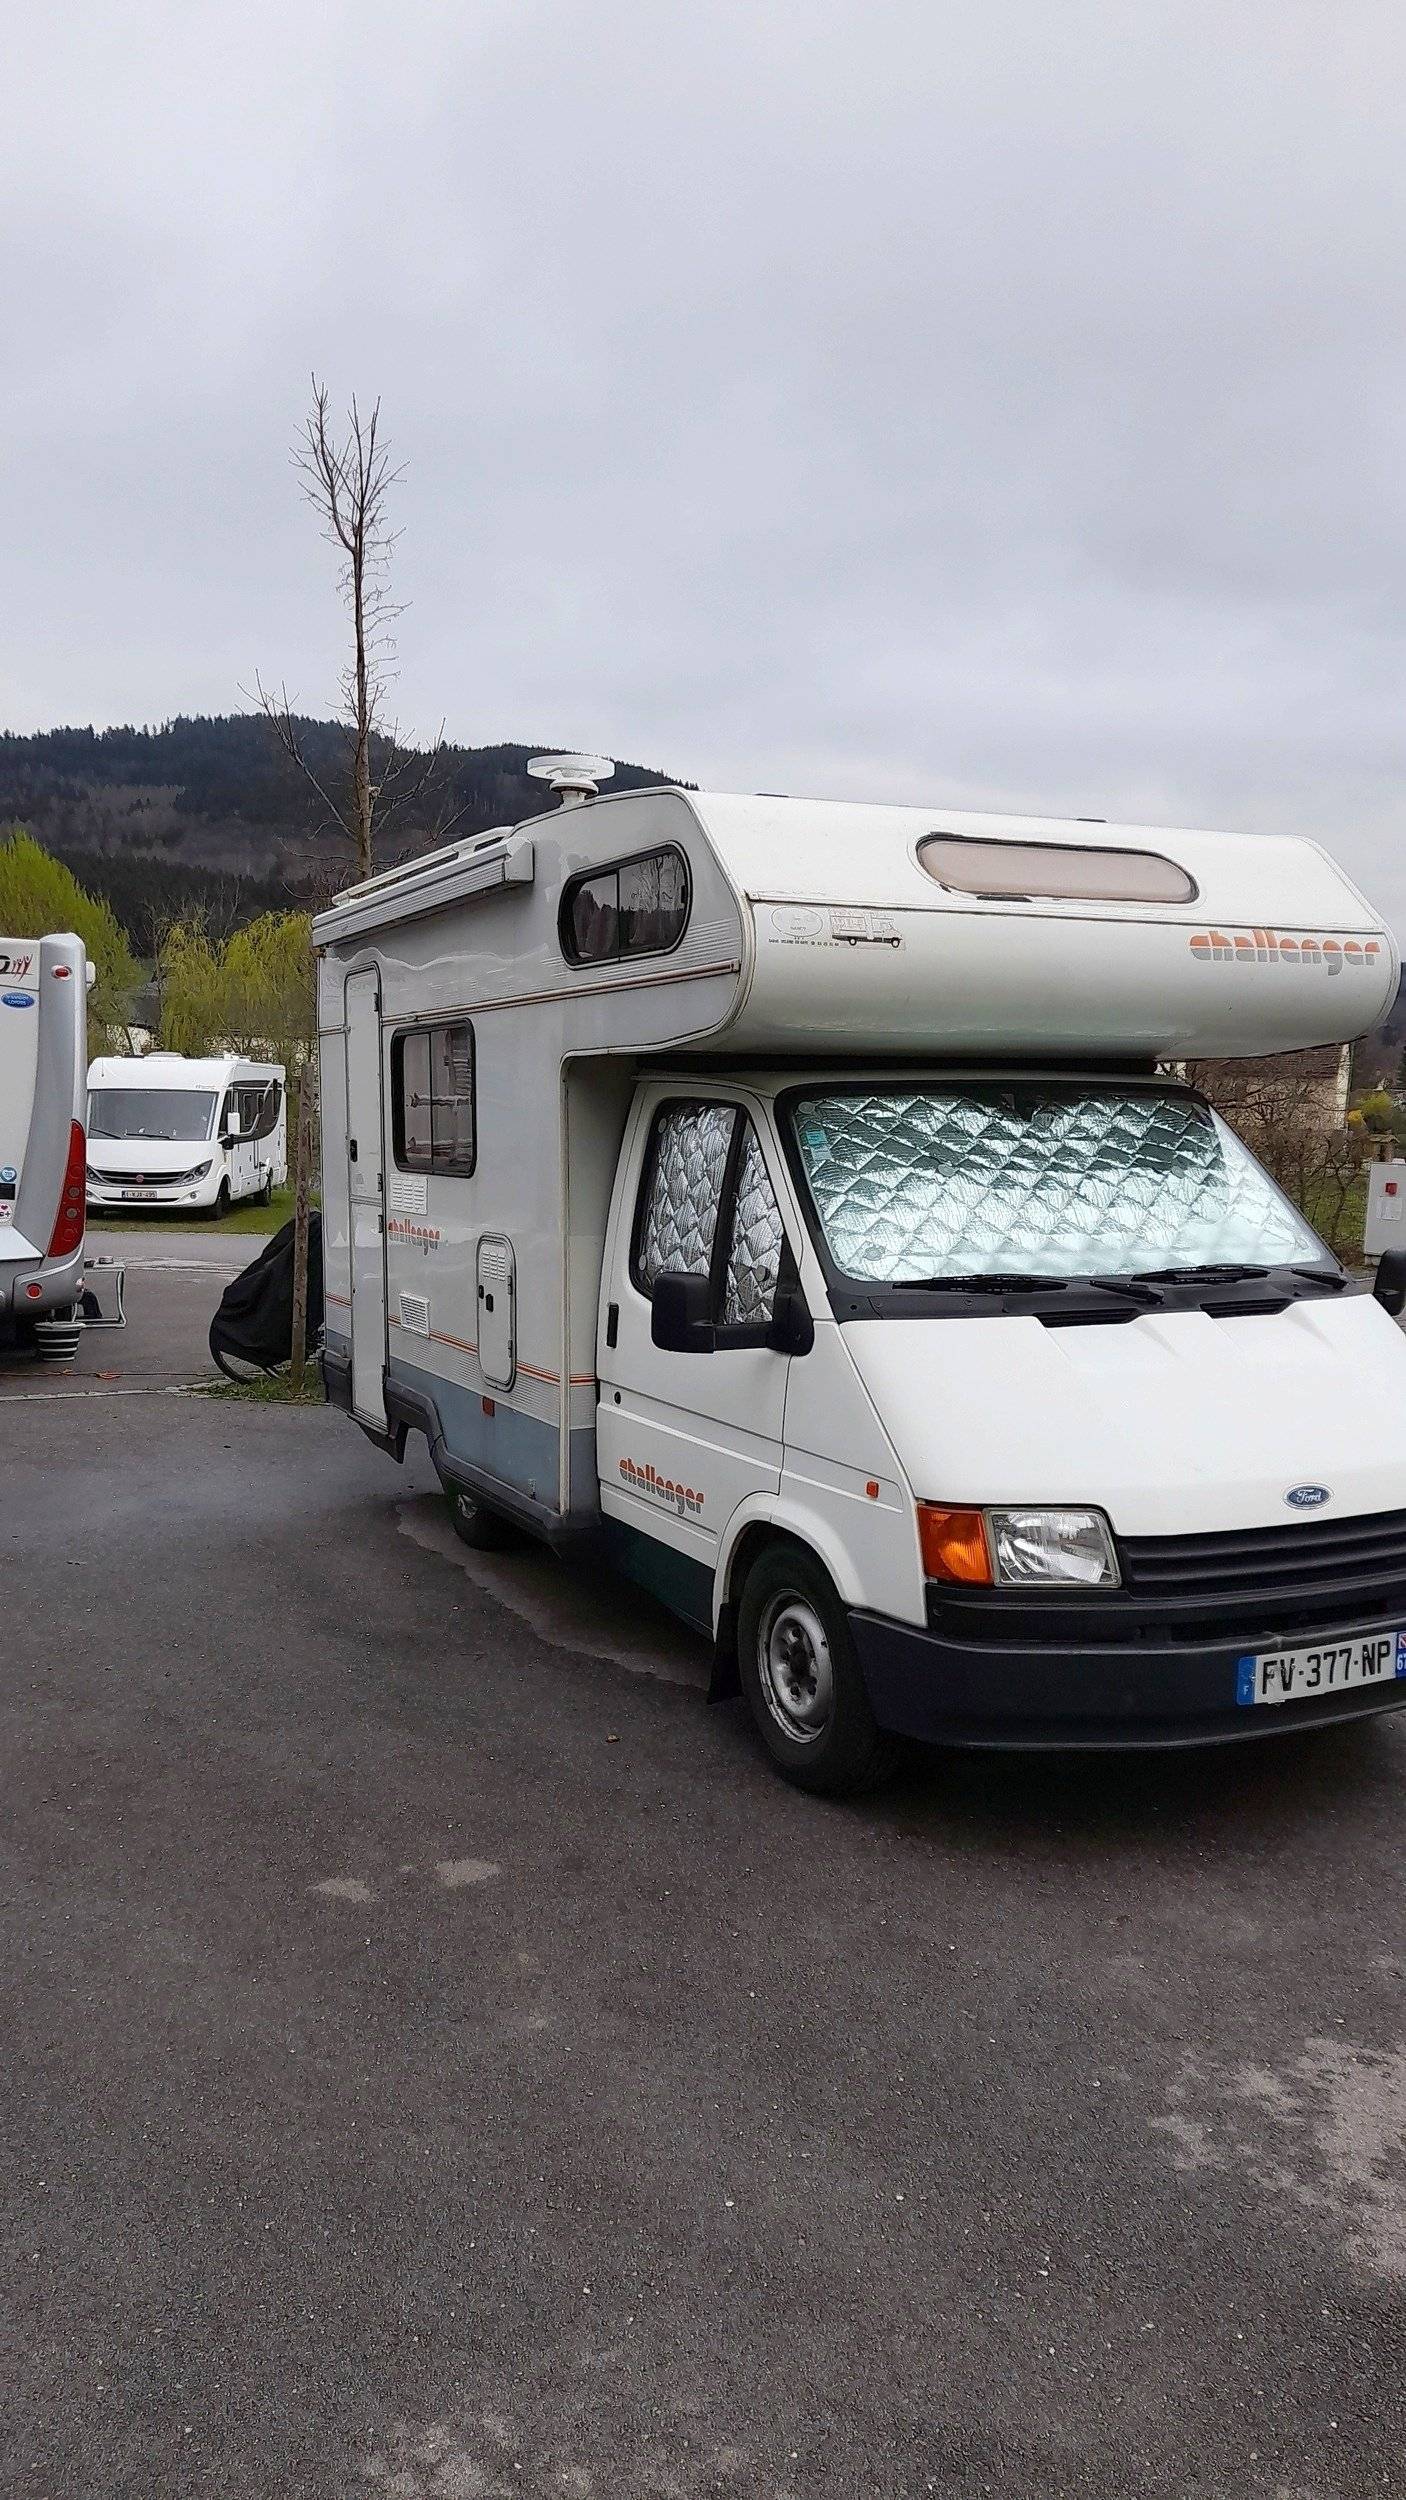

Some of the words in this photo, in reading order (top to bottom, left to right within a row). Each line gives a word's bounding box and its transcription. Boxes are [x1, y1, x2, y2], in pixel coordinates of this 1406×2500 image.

[1190, 929, 1380, 976] challenger
[388, 1218, 441, 1256] challenger
[619, 1457, 705, 1515] challenger
[1296, 1489, 1322, 1503] Ford
[1262, 1640, 1391, 1695] FV-377-NP
